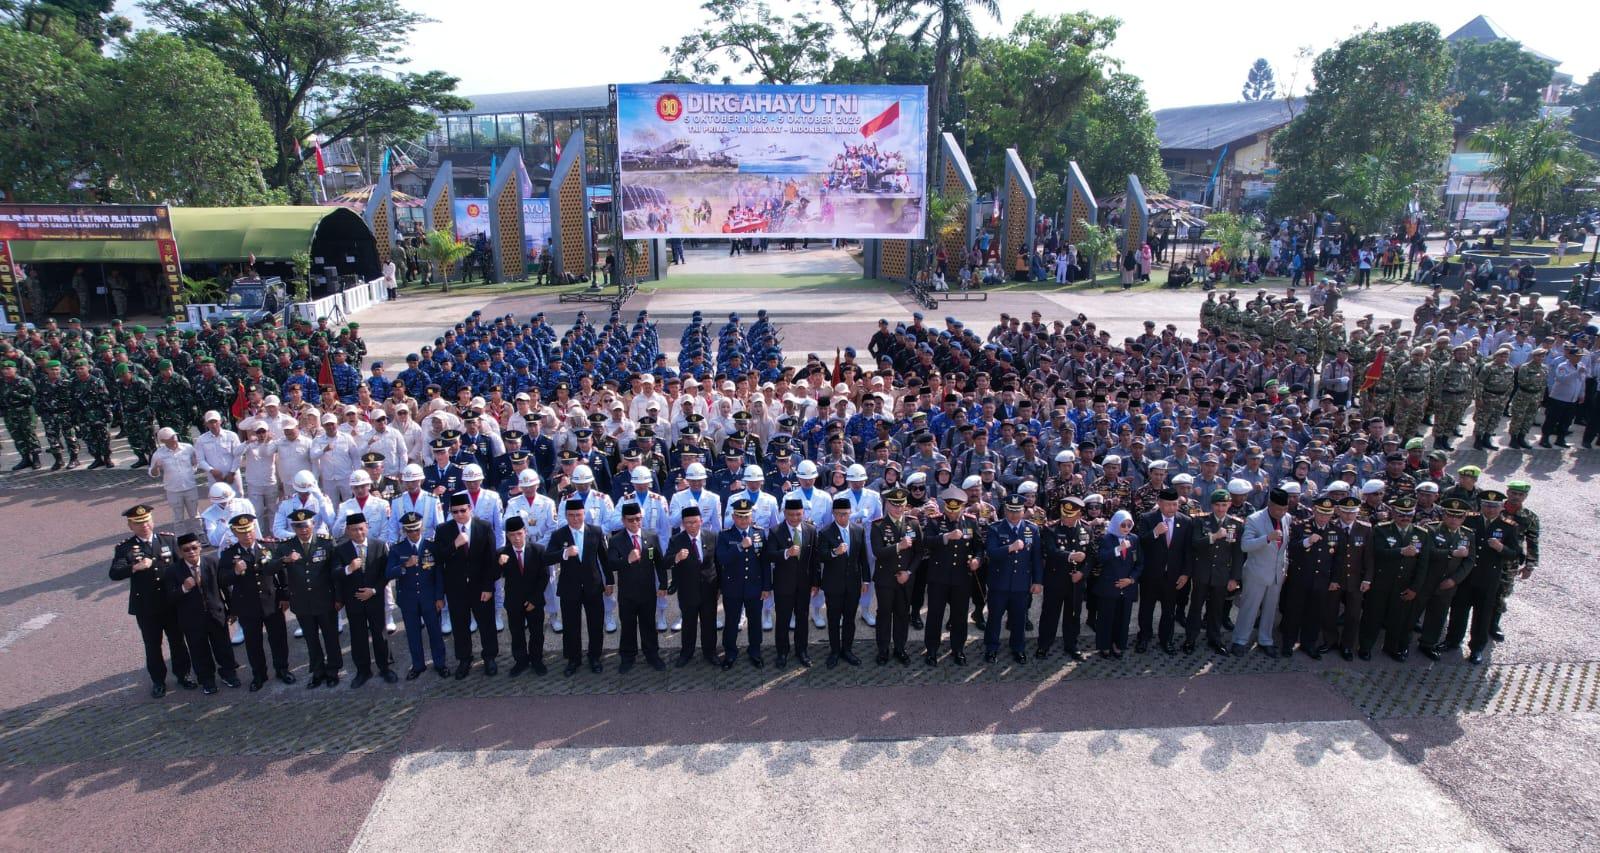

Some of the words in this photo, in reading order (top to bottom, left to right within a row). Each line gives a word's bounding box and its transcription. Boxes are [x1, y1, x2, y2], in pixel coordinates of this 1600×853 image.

[687, 92, 816, 114] DIRGAHAYU
[821, 93, 858, 114] TNI
[684, 114, 690, 124] 5
[693, 114, 740, 124] OKTOBER
[743, 114, 768, 124] 1945
[778, 115, 785, 124] 5
[788, 115, 833, 125] OKTOBER
[836, 116, 861, 125] 2025
[688, 126, 701, 134] TNI
[703, 126, 729, 134] PRIMA
[738, 126, 750, 134] TNI
[752, 126, 782, 134] RAKYAT
[790, 126, 832, 134] INDONESIA
[835, 126, 858, 134] MAJU
